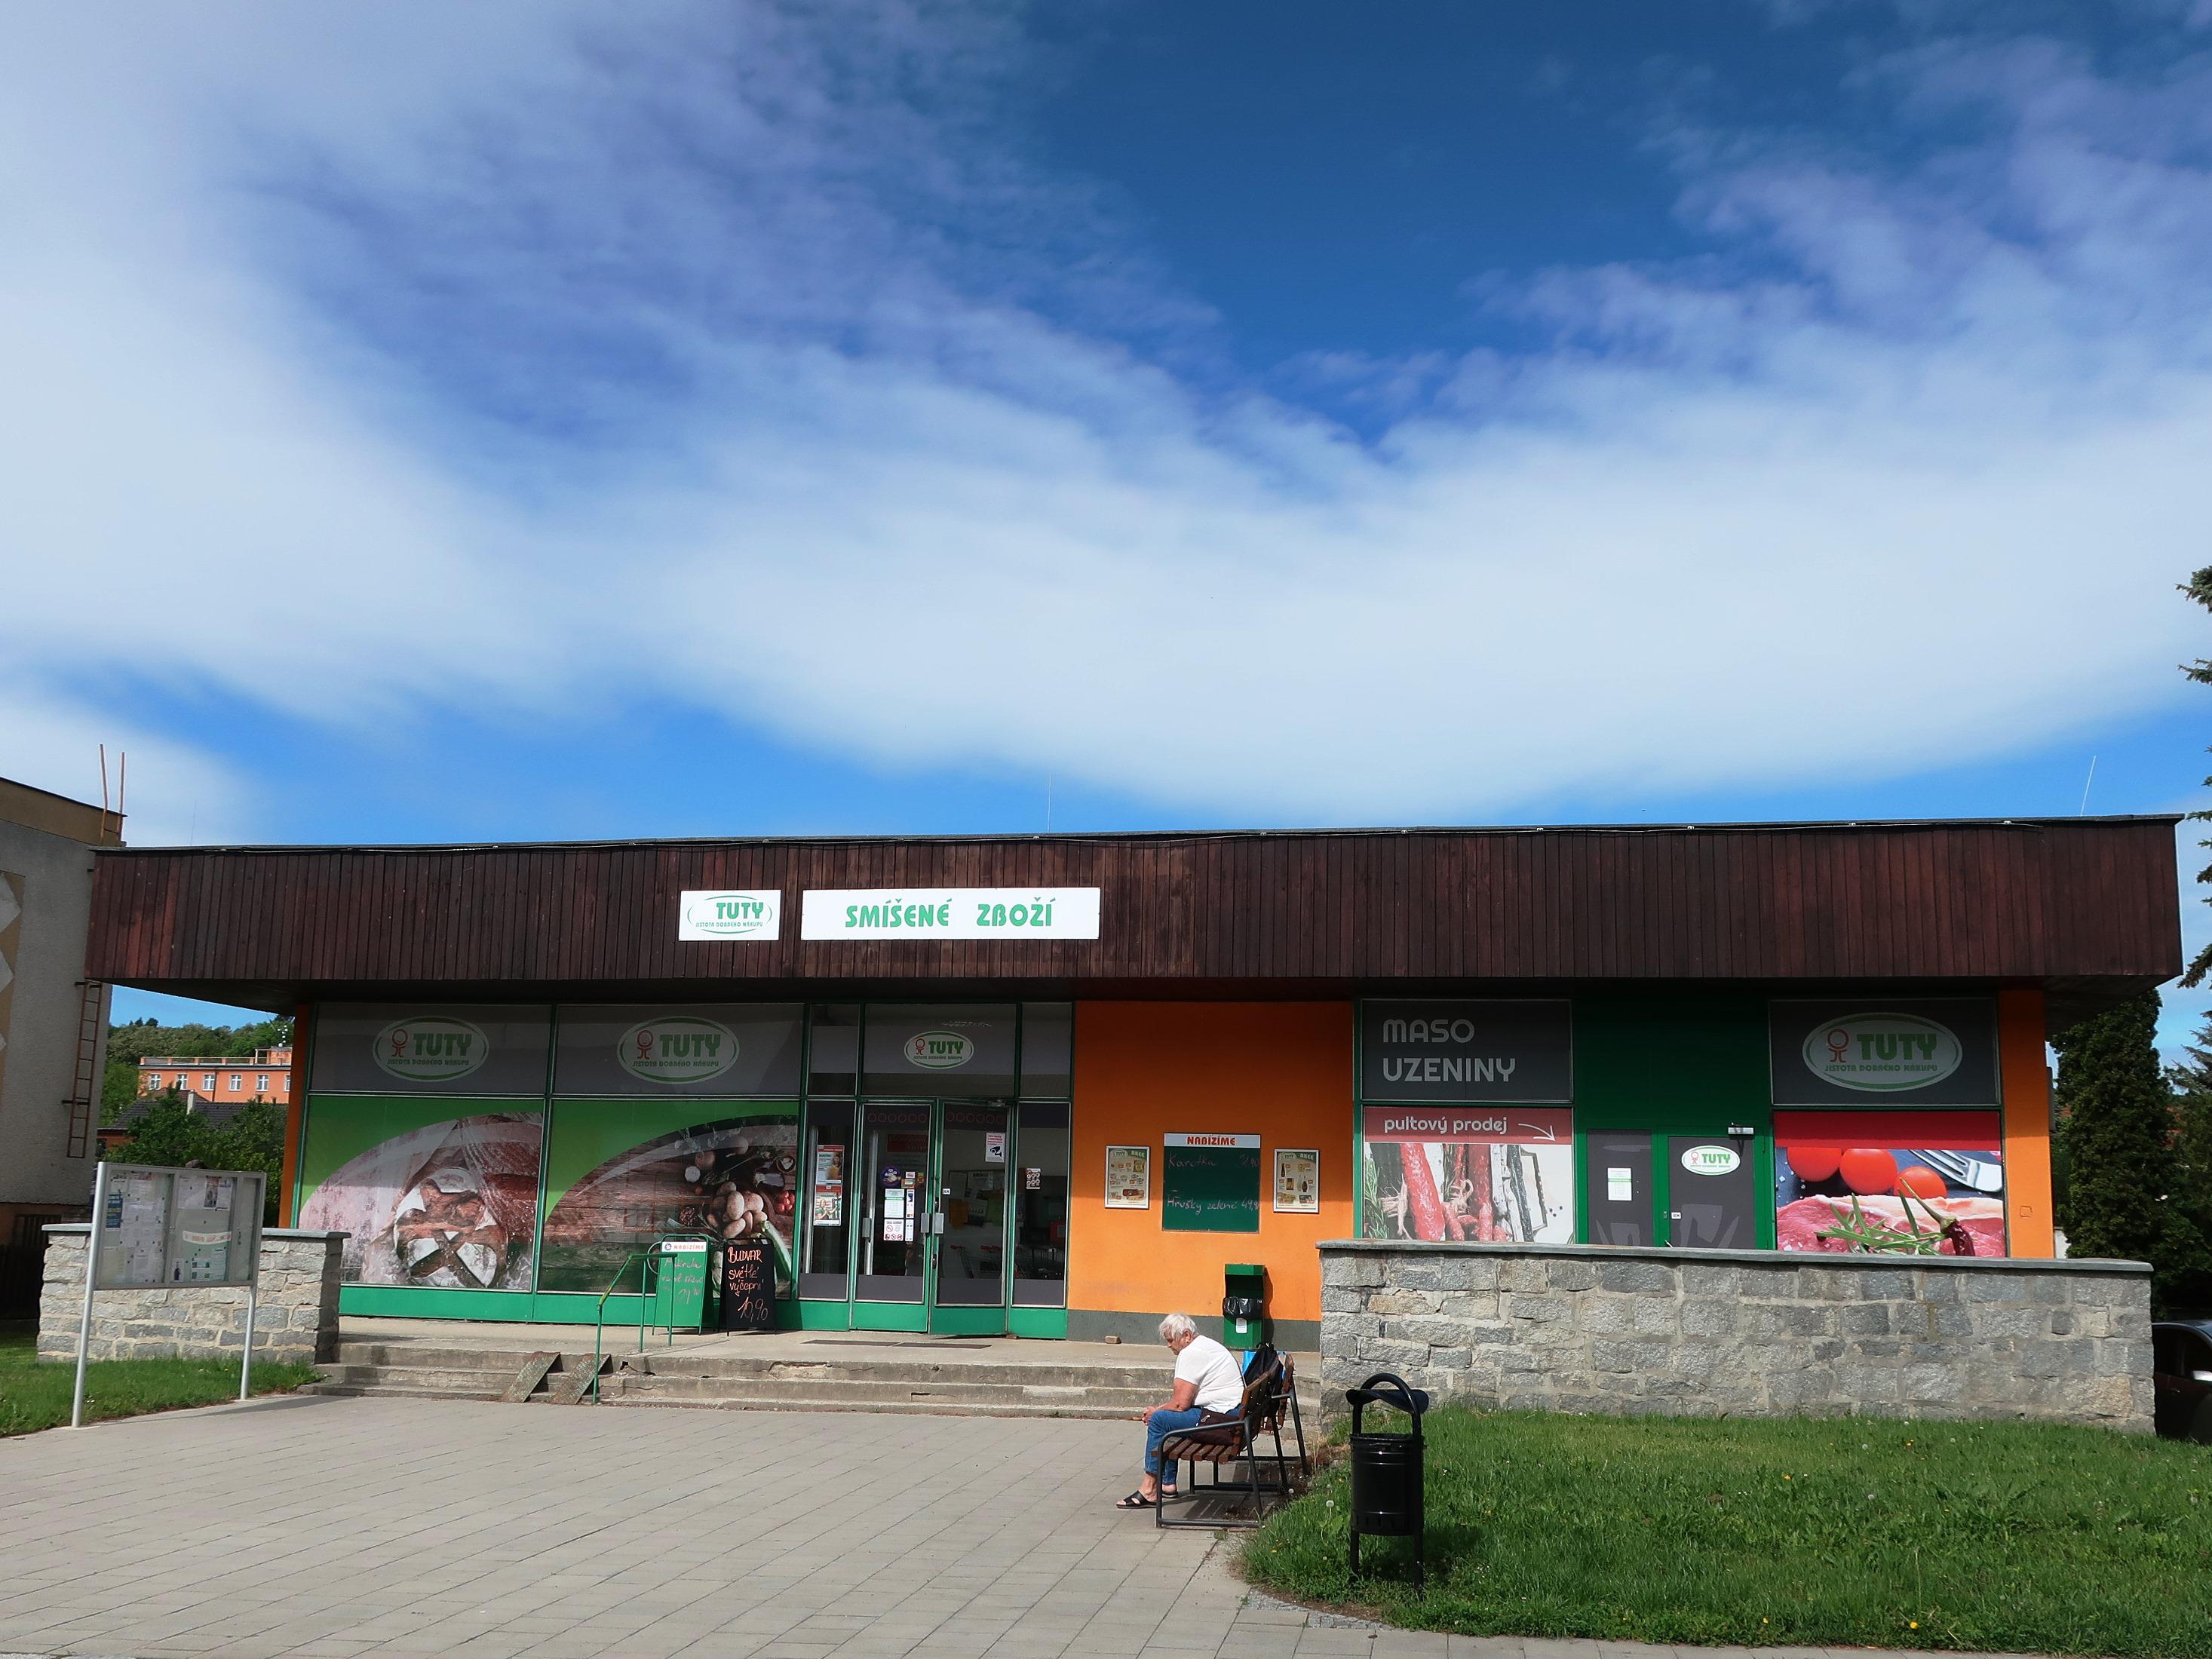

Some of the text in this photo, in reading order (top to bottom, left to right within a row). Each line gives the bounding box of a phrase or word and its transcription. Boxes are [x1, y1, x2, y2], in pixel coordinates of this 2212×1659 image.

[716, 902, 763, 919] TUTY
[845, 897, 1056, 928] SMÍŠENÉ ZBOŽÍ
[1382, 1019, 1475, 1043] MASO
[414, 1033, 471, 1056] TUTY
[660, 1034, 720, 1057] TUTY
[928, 1041, 963, 1054] TUTY
[1857, 1033, 1937, 1060] TUTY
[1382, 1057, 1516, 1082] UZENINY
[1384, 1116, 1507, 1135] pultový prodej
[1187, 1135, 1236, 1145] NABÍZÍME
[1701, 1153, 1731, 1164] TUTY
[727, 1246, 762, 1264] BUDVAR
[728, 1263, 759, 1280] světlé
